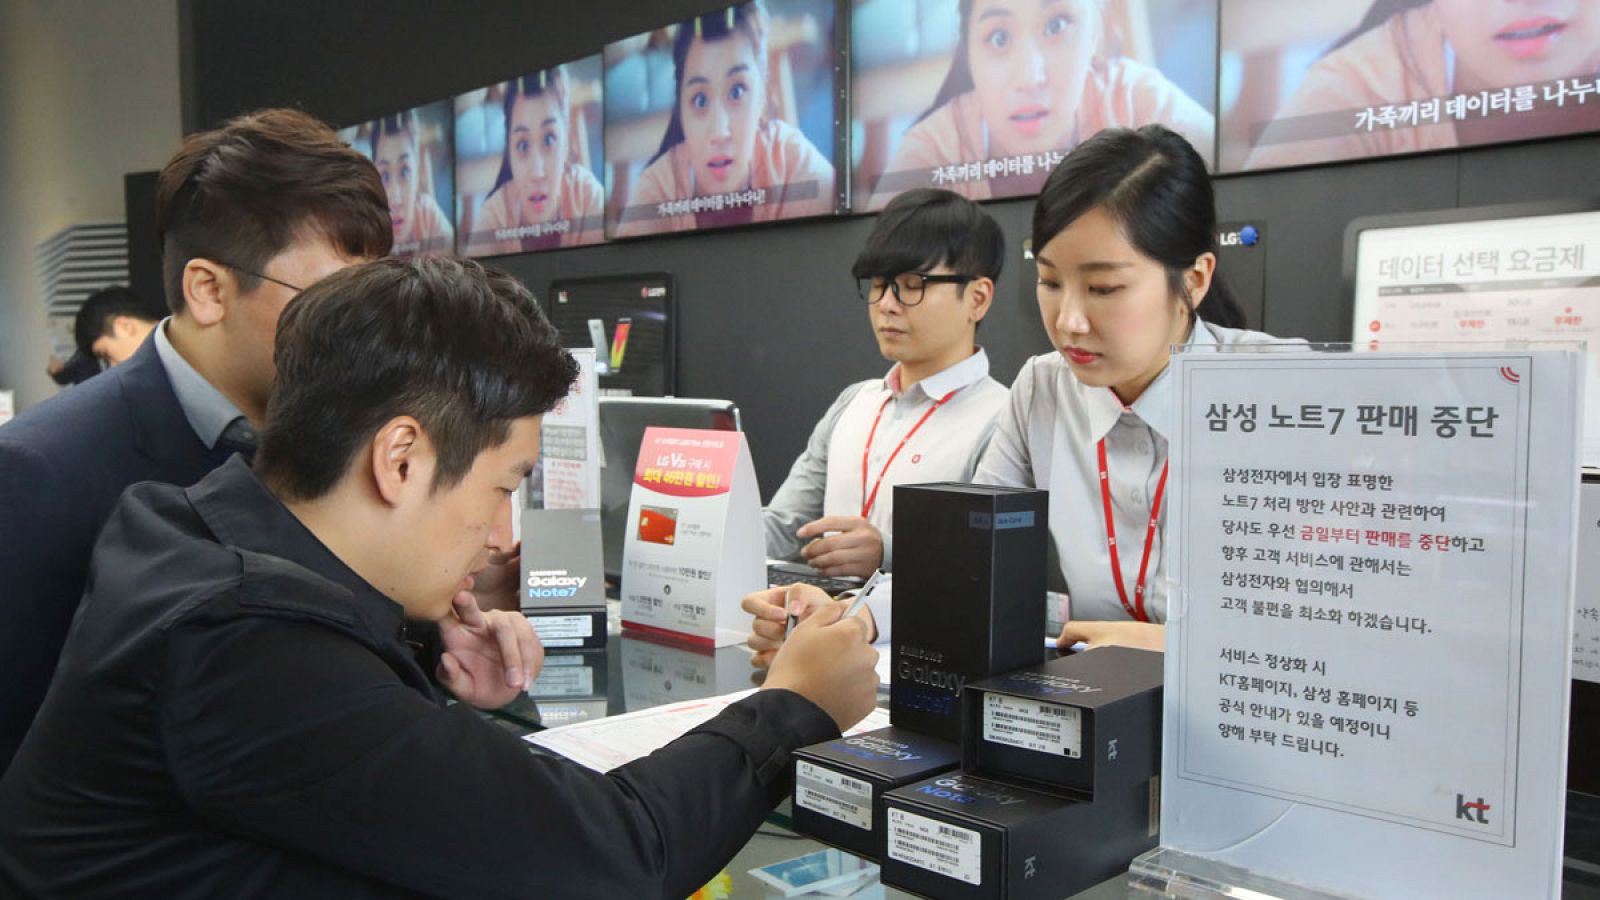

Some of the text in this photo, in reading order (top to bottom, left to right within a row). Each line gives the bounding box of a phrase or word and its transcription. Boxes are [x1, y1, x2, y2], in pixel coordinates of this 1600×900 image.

[1355, 98, 1440, 132] 가족끼리
[1445, 85, 1537, 120] 데이터를
[931, 161, 981, 185] 가족끼리
[984, 154, 1035, 178] 데이터를
[1378, 244, 1585, 280] 데이터 선택 요금제
[1205, 403, 1499, 438] 삼성 노트7 판매 중단
[1223, 468, 1394, 491] 삼성전자에서 입장 표명한
[1222, 494, 1446, 523] 노트7 처리 방안 사안과 관련하여
[1222, 519, 1485, 553] 당사도 우선 금일부터 판매를 중단하고
[1222, 545, 1412, 577] 향후 고객 서비스에 관해서는
[527, 576, 588, 588] Galaxy
[528, 587, 577, 598] Note7
[1221, 571, 1354, 599] 삼성전자와 협의해서
[1220, 597, 1433, 635] 고객 불편을 최소화 하겠습니다.
[1219, 648, 1327, 676] 서비스 정상화 시
[899, 660, 966, 698] Galaxy
[1219, 673, 1419, 717] KT홈페이지, 삼성 홈페이지 등
[1218, 698, 1391, 740] 공식 안내가 있을 예정이니
[846, 738, 923, 761] Galaxy
[1218, 723, 1345, 758] 양해 부탁 드립니다.
[1456, 793, 1491, 825] kt
